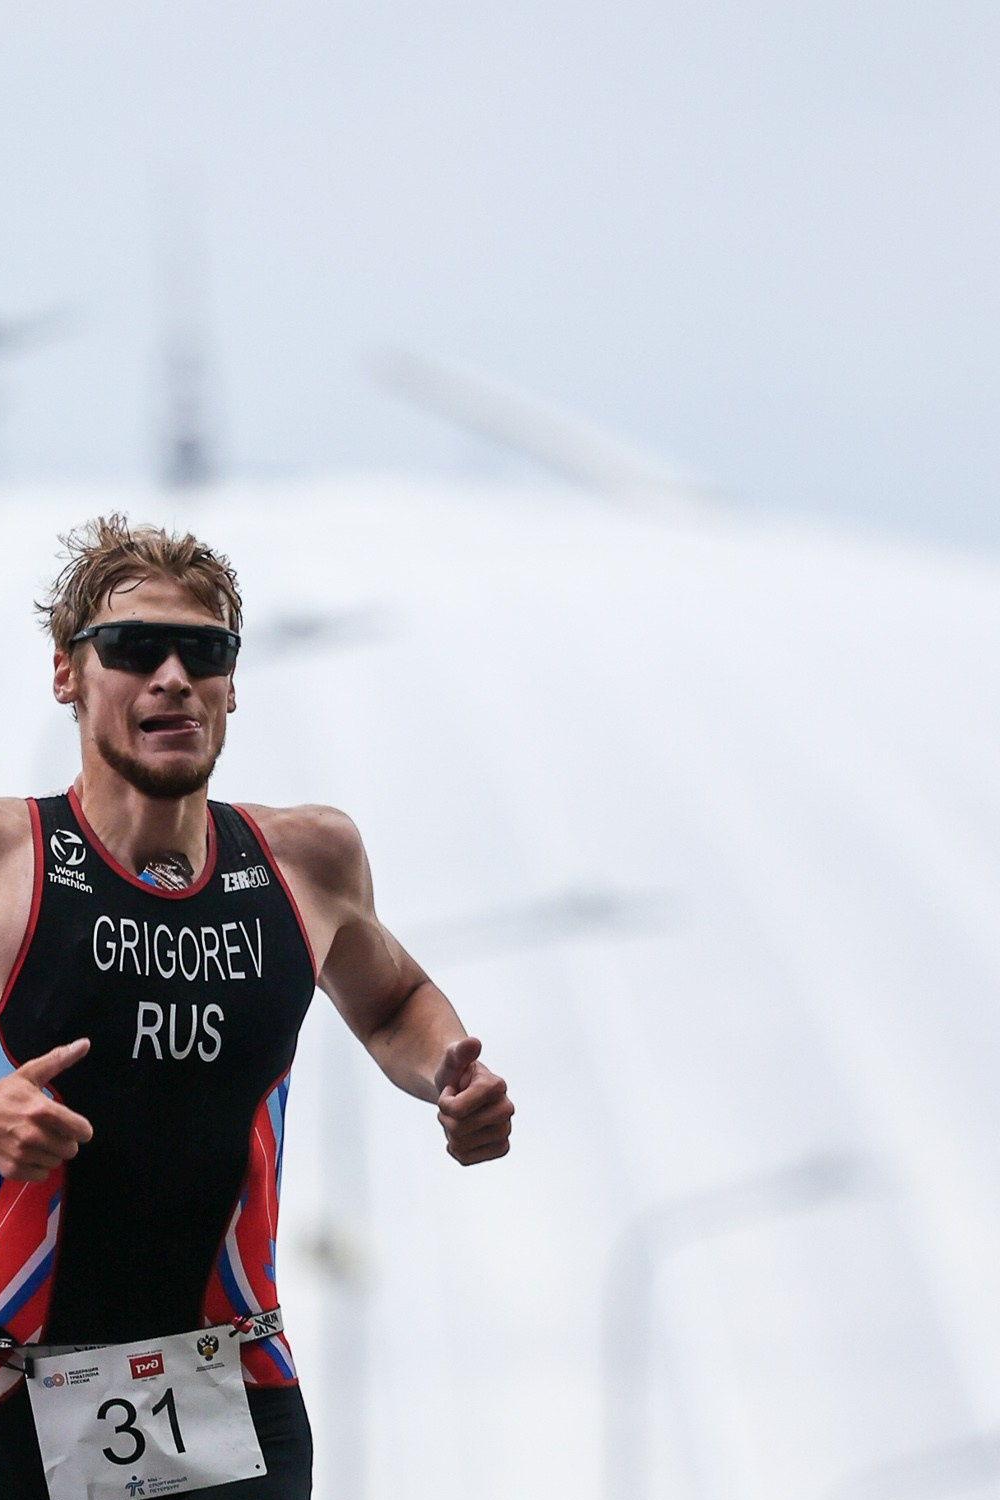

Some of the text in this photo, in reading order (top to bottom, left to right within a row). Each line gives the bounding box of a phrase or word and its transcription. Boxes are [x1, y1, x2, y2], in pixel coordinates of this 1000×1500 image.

[47, 872, 93, 894] Triathlon
[54, 864, 86, 881] World
[92, 915, 262, 982] GRIGOREV
[131, 1000, 225, 1063] RUS
[96, 1386, 187, 1466] 31
